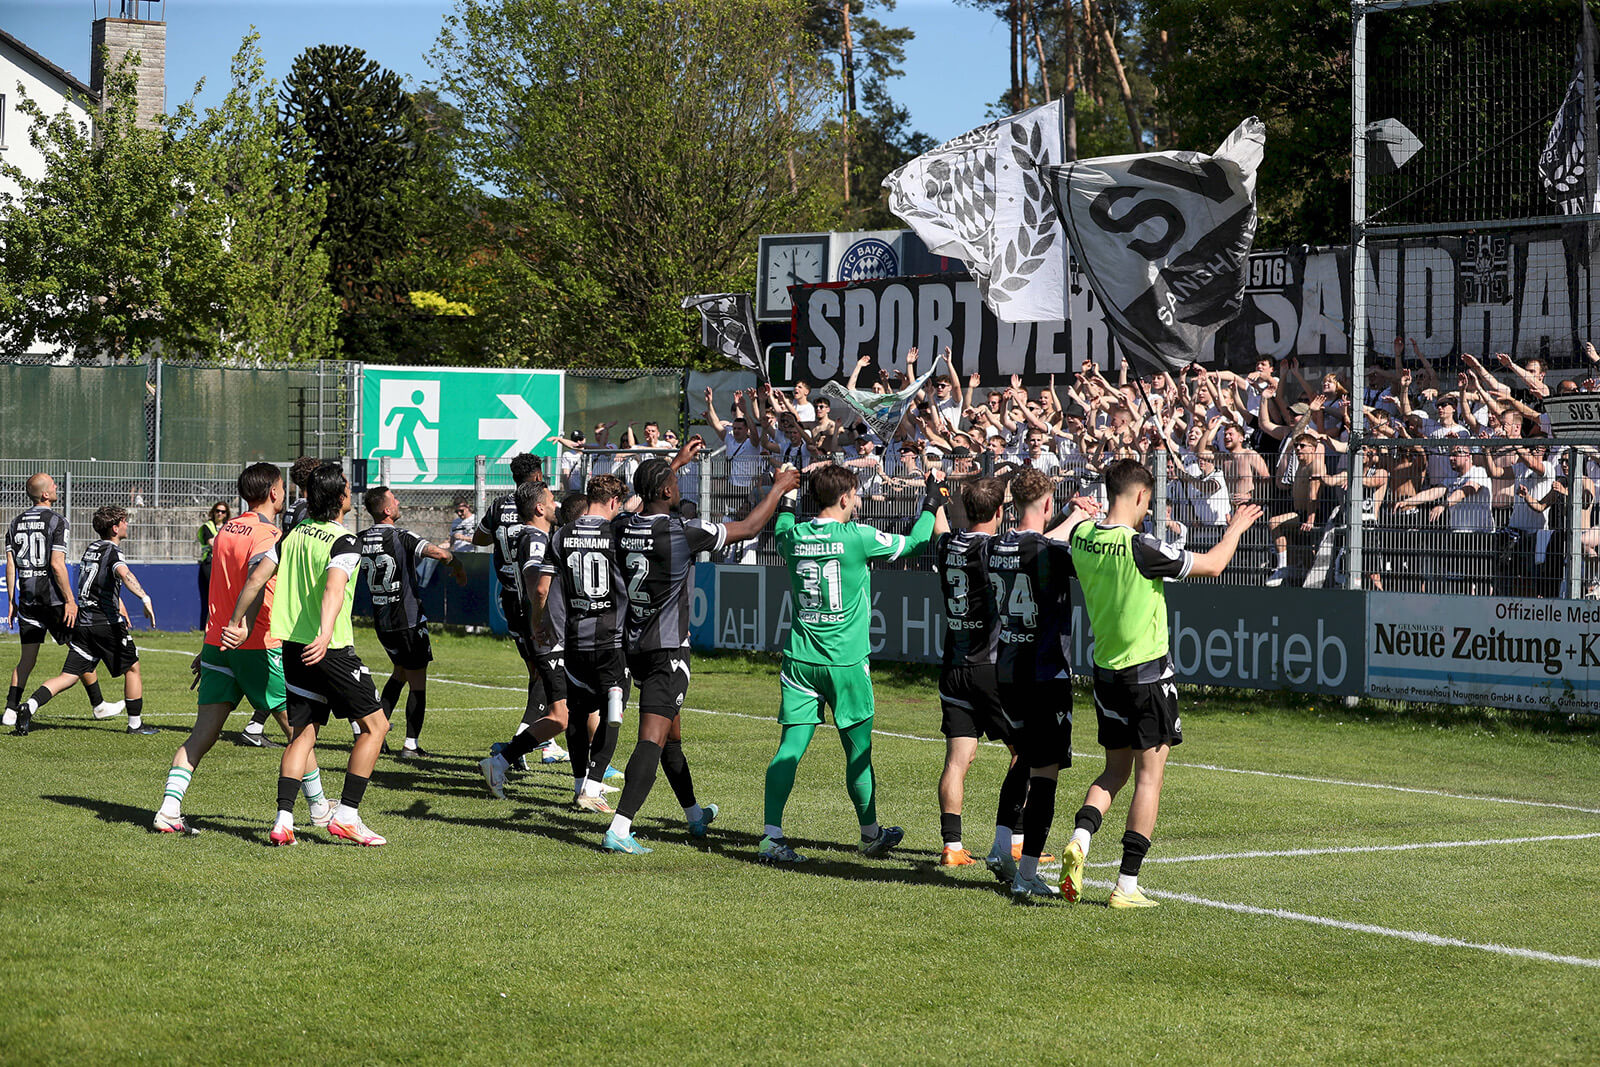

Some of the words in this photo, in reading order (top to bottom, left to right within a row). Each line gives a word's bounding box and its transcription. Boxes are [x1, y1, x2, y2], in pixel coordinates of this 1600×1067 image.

[844, 254, 856, 270] FC
[857, 245, 895, 270] BAYERN
[1569, 402, 1594, 420] SVS
[14, 531, 46, 568] 20
[563, 536, 610, 550] HERRMANN
[621, 538, 654, 551] SCHULZ
[794, 541, 846, 556] SCHNELLER
[1075, 535, 1126, 558] macron
[990, 554, 1020, 568] GIPSON
[360, 553, 400, 594] 22
[566, 551, 610, 598] 10
[626, 552, 651, 603] 2
[796, 559, 843, 611] 31
[947, 568, 969, 616] 3
[590, 600, 611, 610] SSC
[1496, 602, 1562, 622] Offizielle
[722, 607, 758, 646] AH
[821, 613, 846, 622] SSC
[963, 620, 984, 629] SSC
[1011, 633, 1034, 643] SSC
[1373, 622, 1446, 658] Neue
[1452, 626, 1562, 676] Zeitung
[1371, 684, 1393, 693] Druck-
[1395, 686, 1409, 695] und
[1411, 686, 1450, 698] Pressehaus
[1453, 690, 1489, 701] Naumann
[1491, 693, 1514, 702] GmbH
[1516, 695, 1523, 703] &
